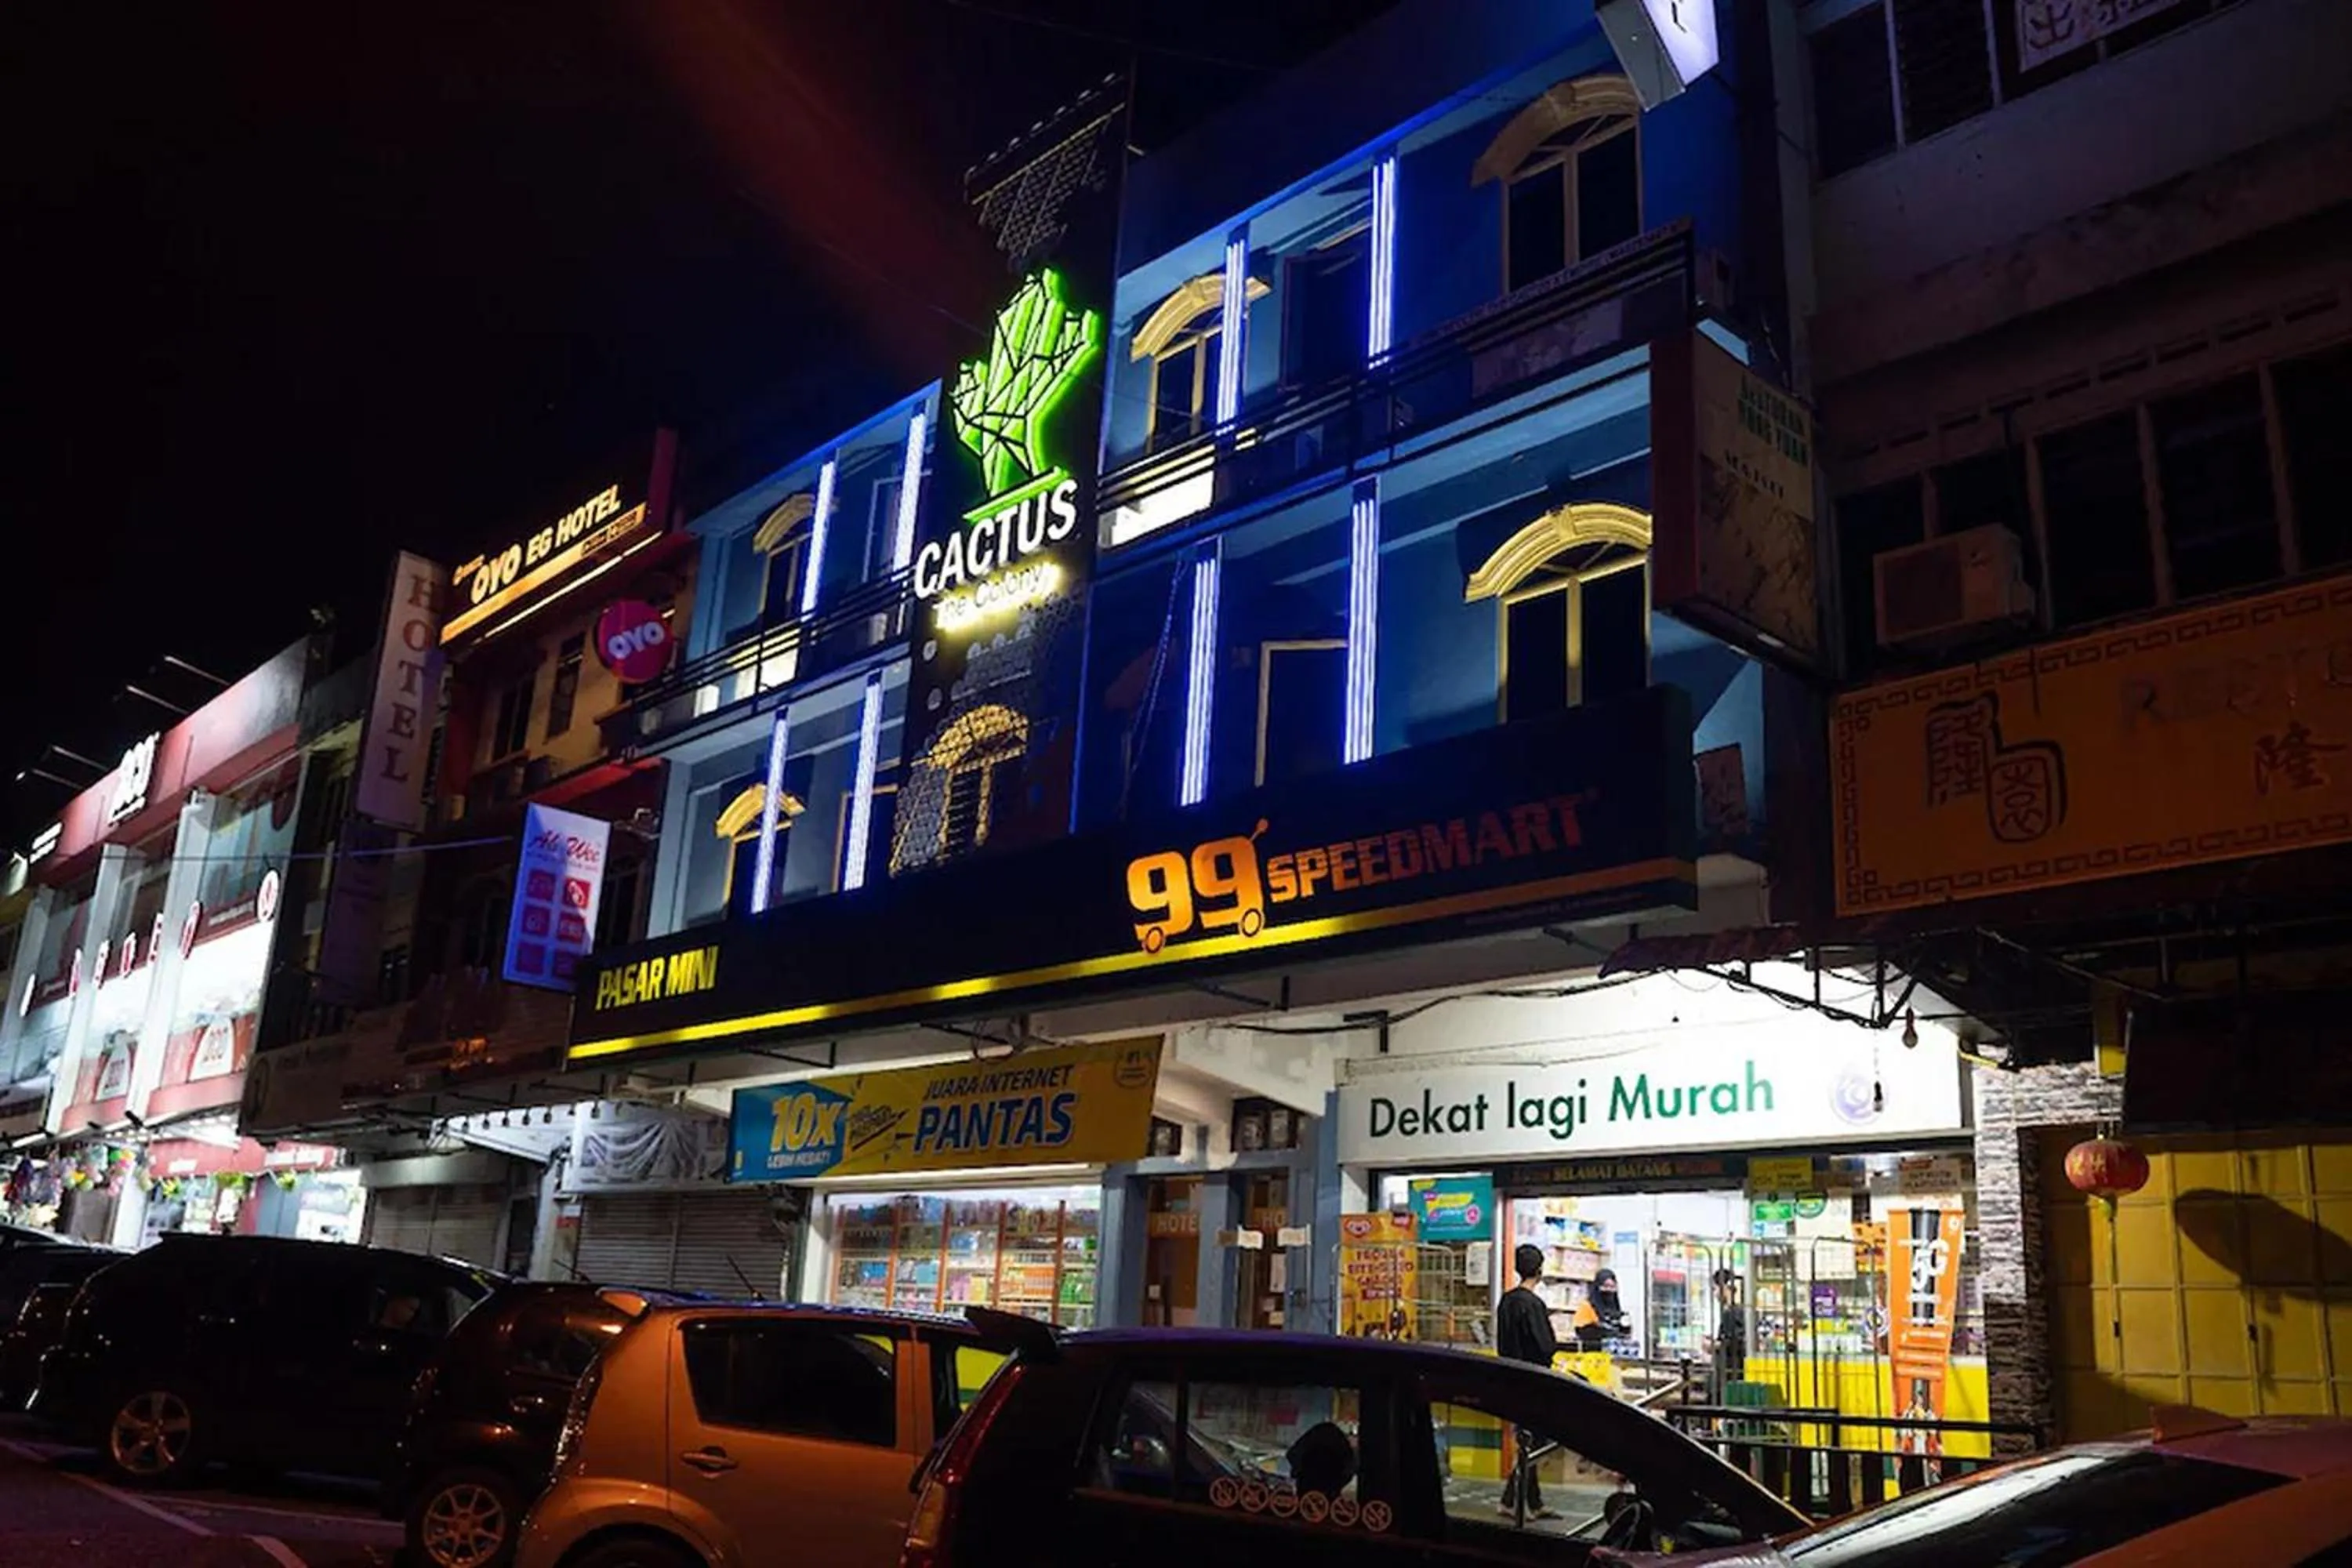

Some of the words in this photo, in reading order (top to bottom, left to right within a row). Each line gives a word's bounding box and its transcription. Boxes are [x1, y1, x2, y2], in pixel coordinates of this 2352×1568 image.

[471, 544, 521, 604] OYO
[525, 527, 554, 566] EG
[554, 484, 621, 548] HOTEL
[914, 479, 1079, 599] CACTUS
[608, 621, 665, 659] OYO
[380, 574, 439, 782] HOTEL
[1126, 833, 1265, 952] 99
[1267, 792, 1585, 904] SPEEDMART
[595, 960, 665, 1011] PASAR
[665, 945, 719, 996] MINI
[923, 1076, 980, 1100] JUARA
[979, 1064, 1075, 1093] INTERNET
[1369, 1087, 1490, 1138] Dekat
[1505, 1078, 1587, 1139] lagi
[1608, 1061, 1774, 1122] Murah
[913, 1091, 1076, 1154] PANTAS
[1156, 1214, 1198, 1232] HOTE
[1911, 1236, 1951, 1294] 5G
